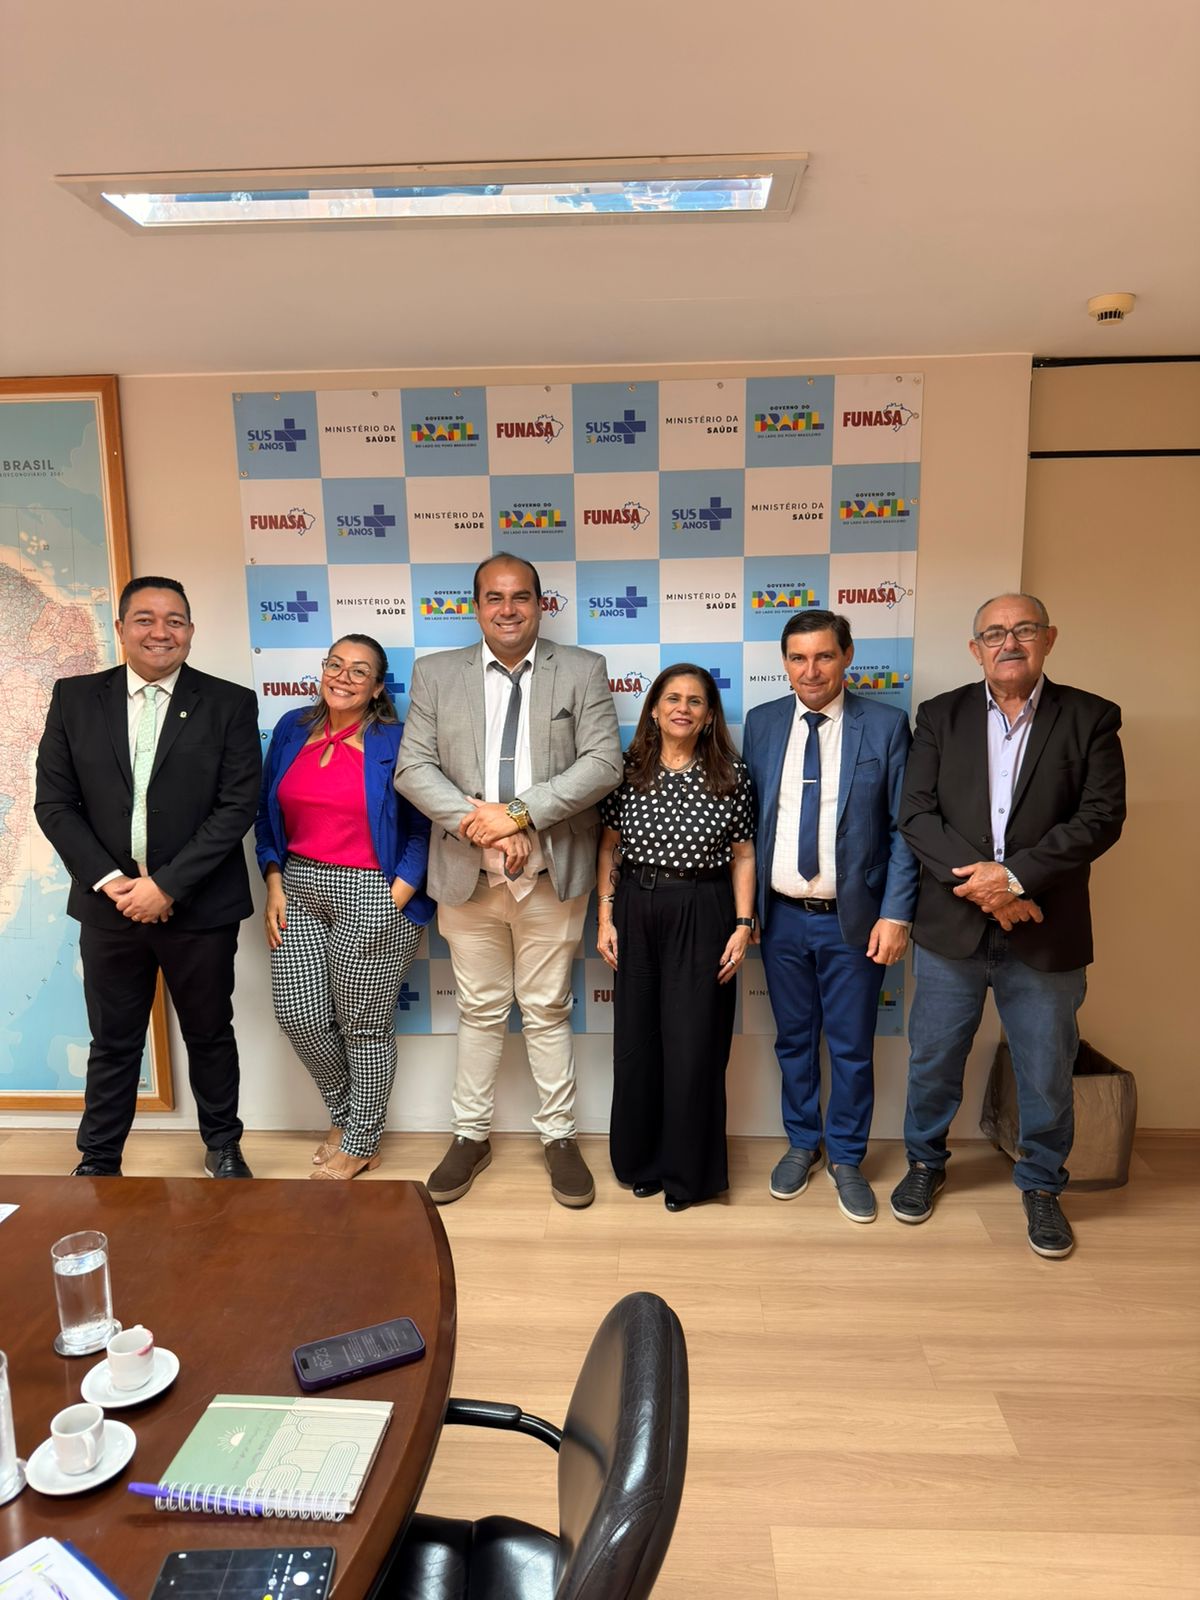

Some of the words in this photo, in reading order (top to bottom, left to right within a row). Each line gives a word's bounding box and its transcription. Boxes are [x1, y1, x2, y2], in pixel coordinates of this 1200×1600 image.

[666, 416, 722, 424] MINISTÉRIO
[754, 411, 824, 432] BRASIL
[843, 409, 903, 428] FUNASA
[410, 422, 479, 442] BRASIL
[496, 422, 554, 439] FUNASA
[586, 422, 611, 433] SUS
[707, 425, 737, 434] SAÚDE
[248, 430, 272, 441] SUS
[596, 434, 622, 443] ANOS
[259, 442, 284, 450] ANOS
[3, 460, 54, 471] BRASIL
[752, 502, 807, 511] MINISTÉRIO
[839, 498, 910, 520] BRASIL
[498, 510, 567, 529] BRASIL
[583, 507, 640, 525] FUNASA
[672, 509, 696, 520] SUS
[793, 512, 823, 520] SAÚDE
[250, 514, 307, 530] FUNASA
[337, 516, 361, 527] SUS
[455, 521, 484, 529] SAÚDE
[682, 521, 708, 529] ANOS
[666, 592, 720, 600] MINISTÉRIO
[751, 588, 820, 609] BRASIL
[838, 588, 897, 604] FUNASA
[260, 601, 284, 612] SUS
[420, 597, 473, 616] BRASI
[589, 597, 613, 608] SUS
[271, 613, 296, 621] ANOS
[600, 609, 625, 617] ANOS
[608, 678, 642, 692] NASA
[843, 671, 904, 690] RASIL
[263, 682, 318, 696] FUNASA
